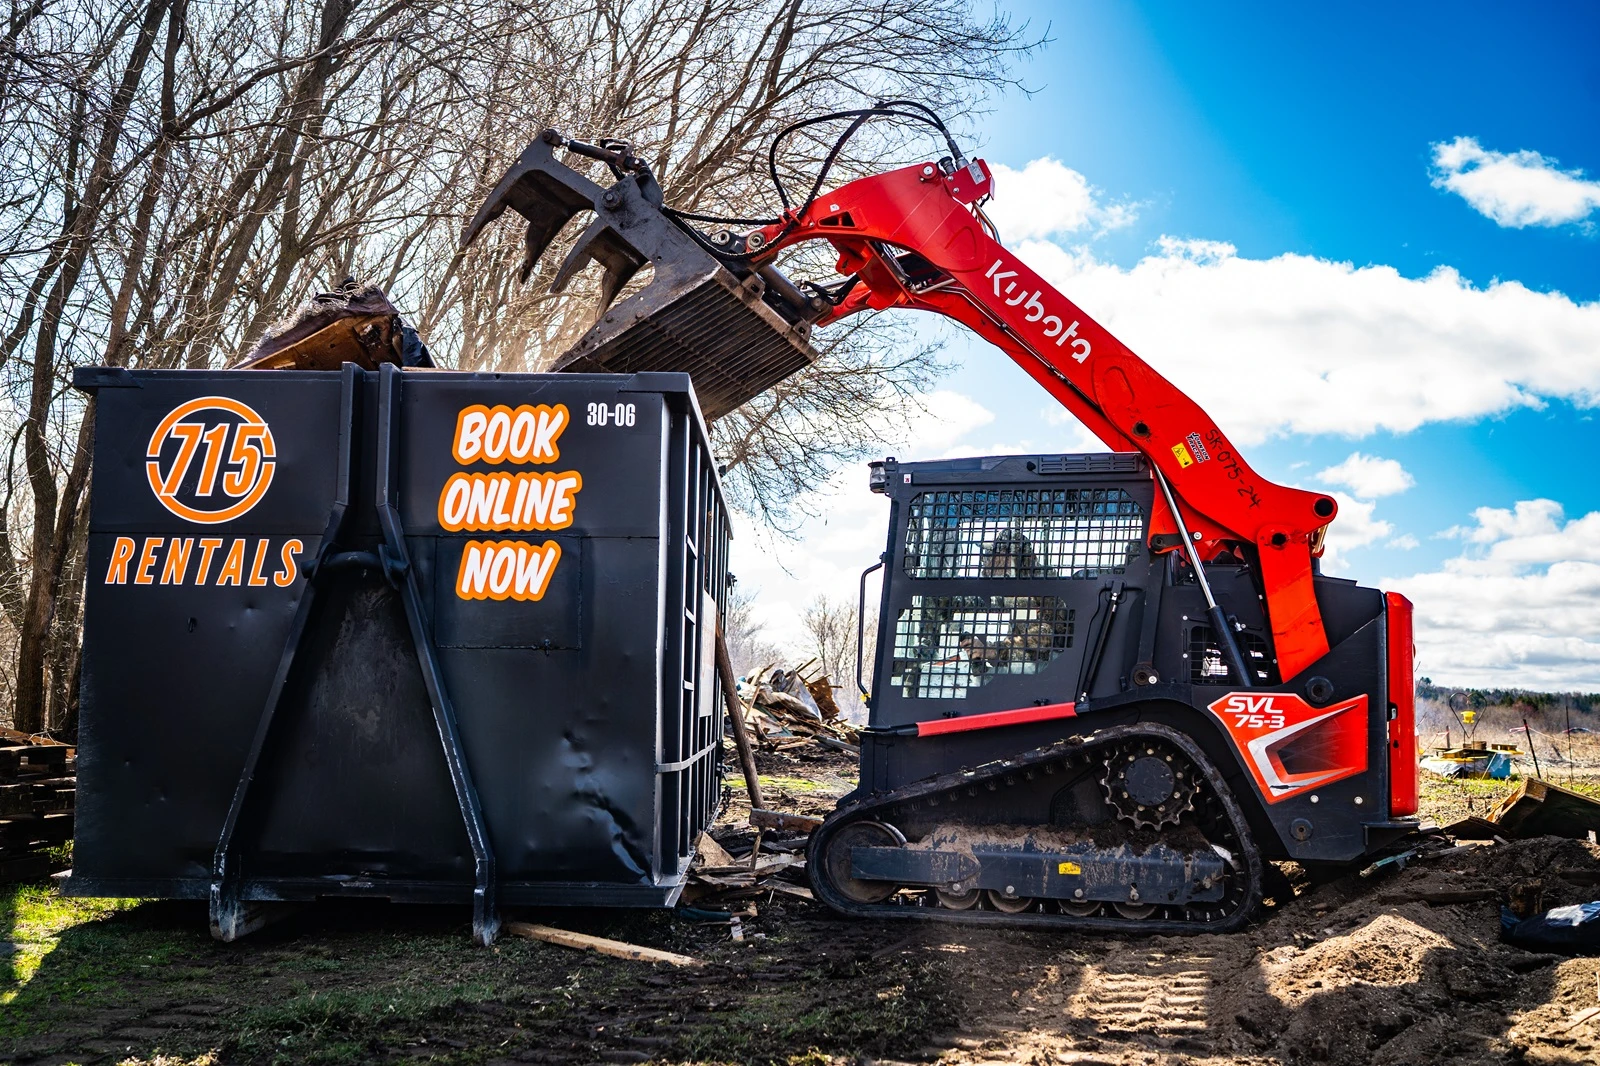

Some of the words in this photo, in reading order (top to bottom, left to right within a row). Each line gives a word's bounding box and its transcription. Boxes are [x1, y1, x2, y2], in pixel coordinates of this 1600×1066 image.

[985, 259, 1091, 364] Kubota
[457, 409, 566, 461] BOOK
[587, 402, 636, 427] 30-06
[159, 422, 269, 497] 715
[1186, 435, 1204, 464] TRACTOR
[1192, 432, 1210, 461] JOHNSON
[442, 476, 578, 526] ONLINE
[105, 537, 304, 587] RENTALS
[460, 546, 557, 596] NOW
[1224, 696, 1284, 714] SVL
[1234, 714, 1286, 729] 75-3
